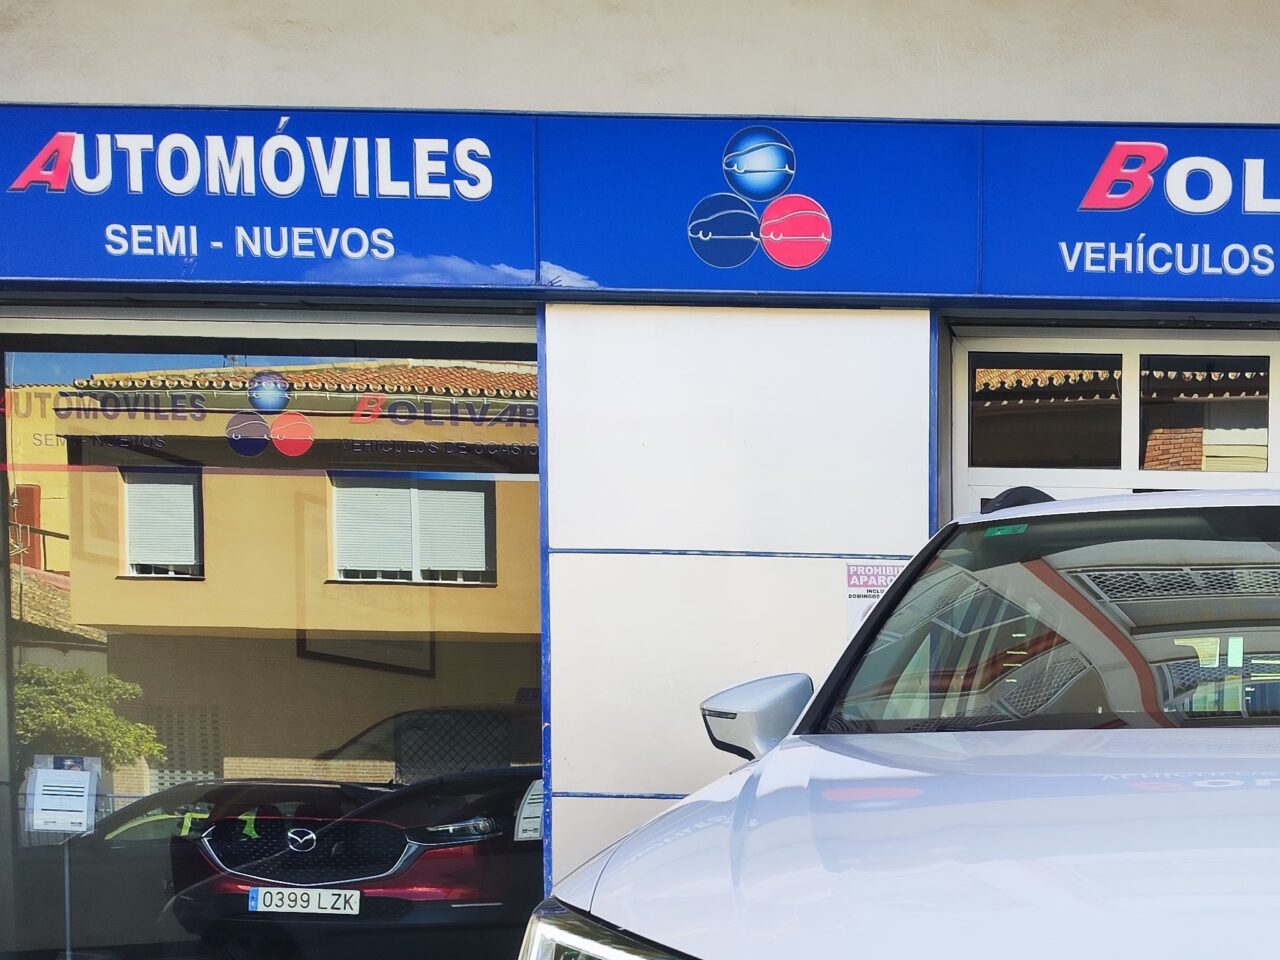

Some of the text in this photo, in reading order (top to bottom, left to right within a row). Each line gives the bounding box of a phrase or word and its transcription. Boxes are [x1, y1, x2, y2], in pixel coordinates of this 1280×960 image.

[8, 116, 493, 201] AUTOMÓVILES
[104, 223, 198, 257] SEMI
[235, 227, 396, 260] NUEVOS
[1058, 233, 1275, 275] VEHÍCULOS
[32, 433, 71, 448] SEM
[263, 891, 354, 911] 0399 LZK
